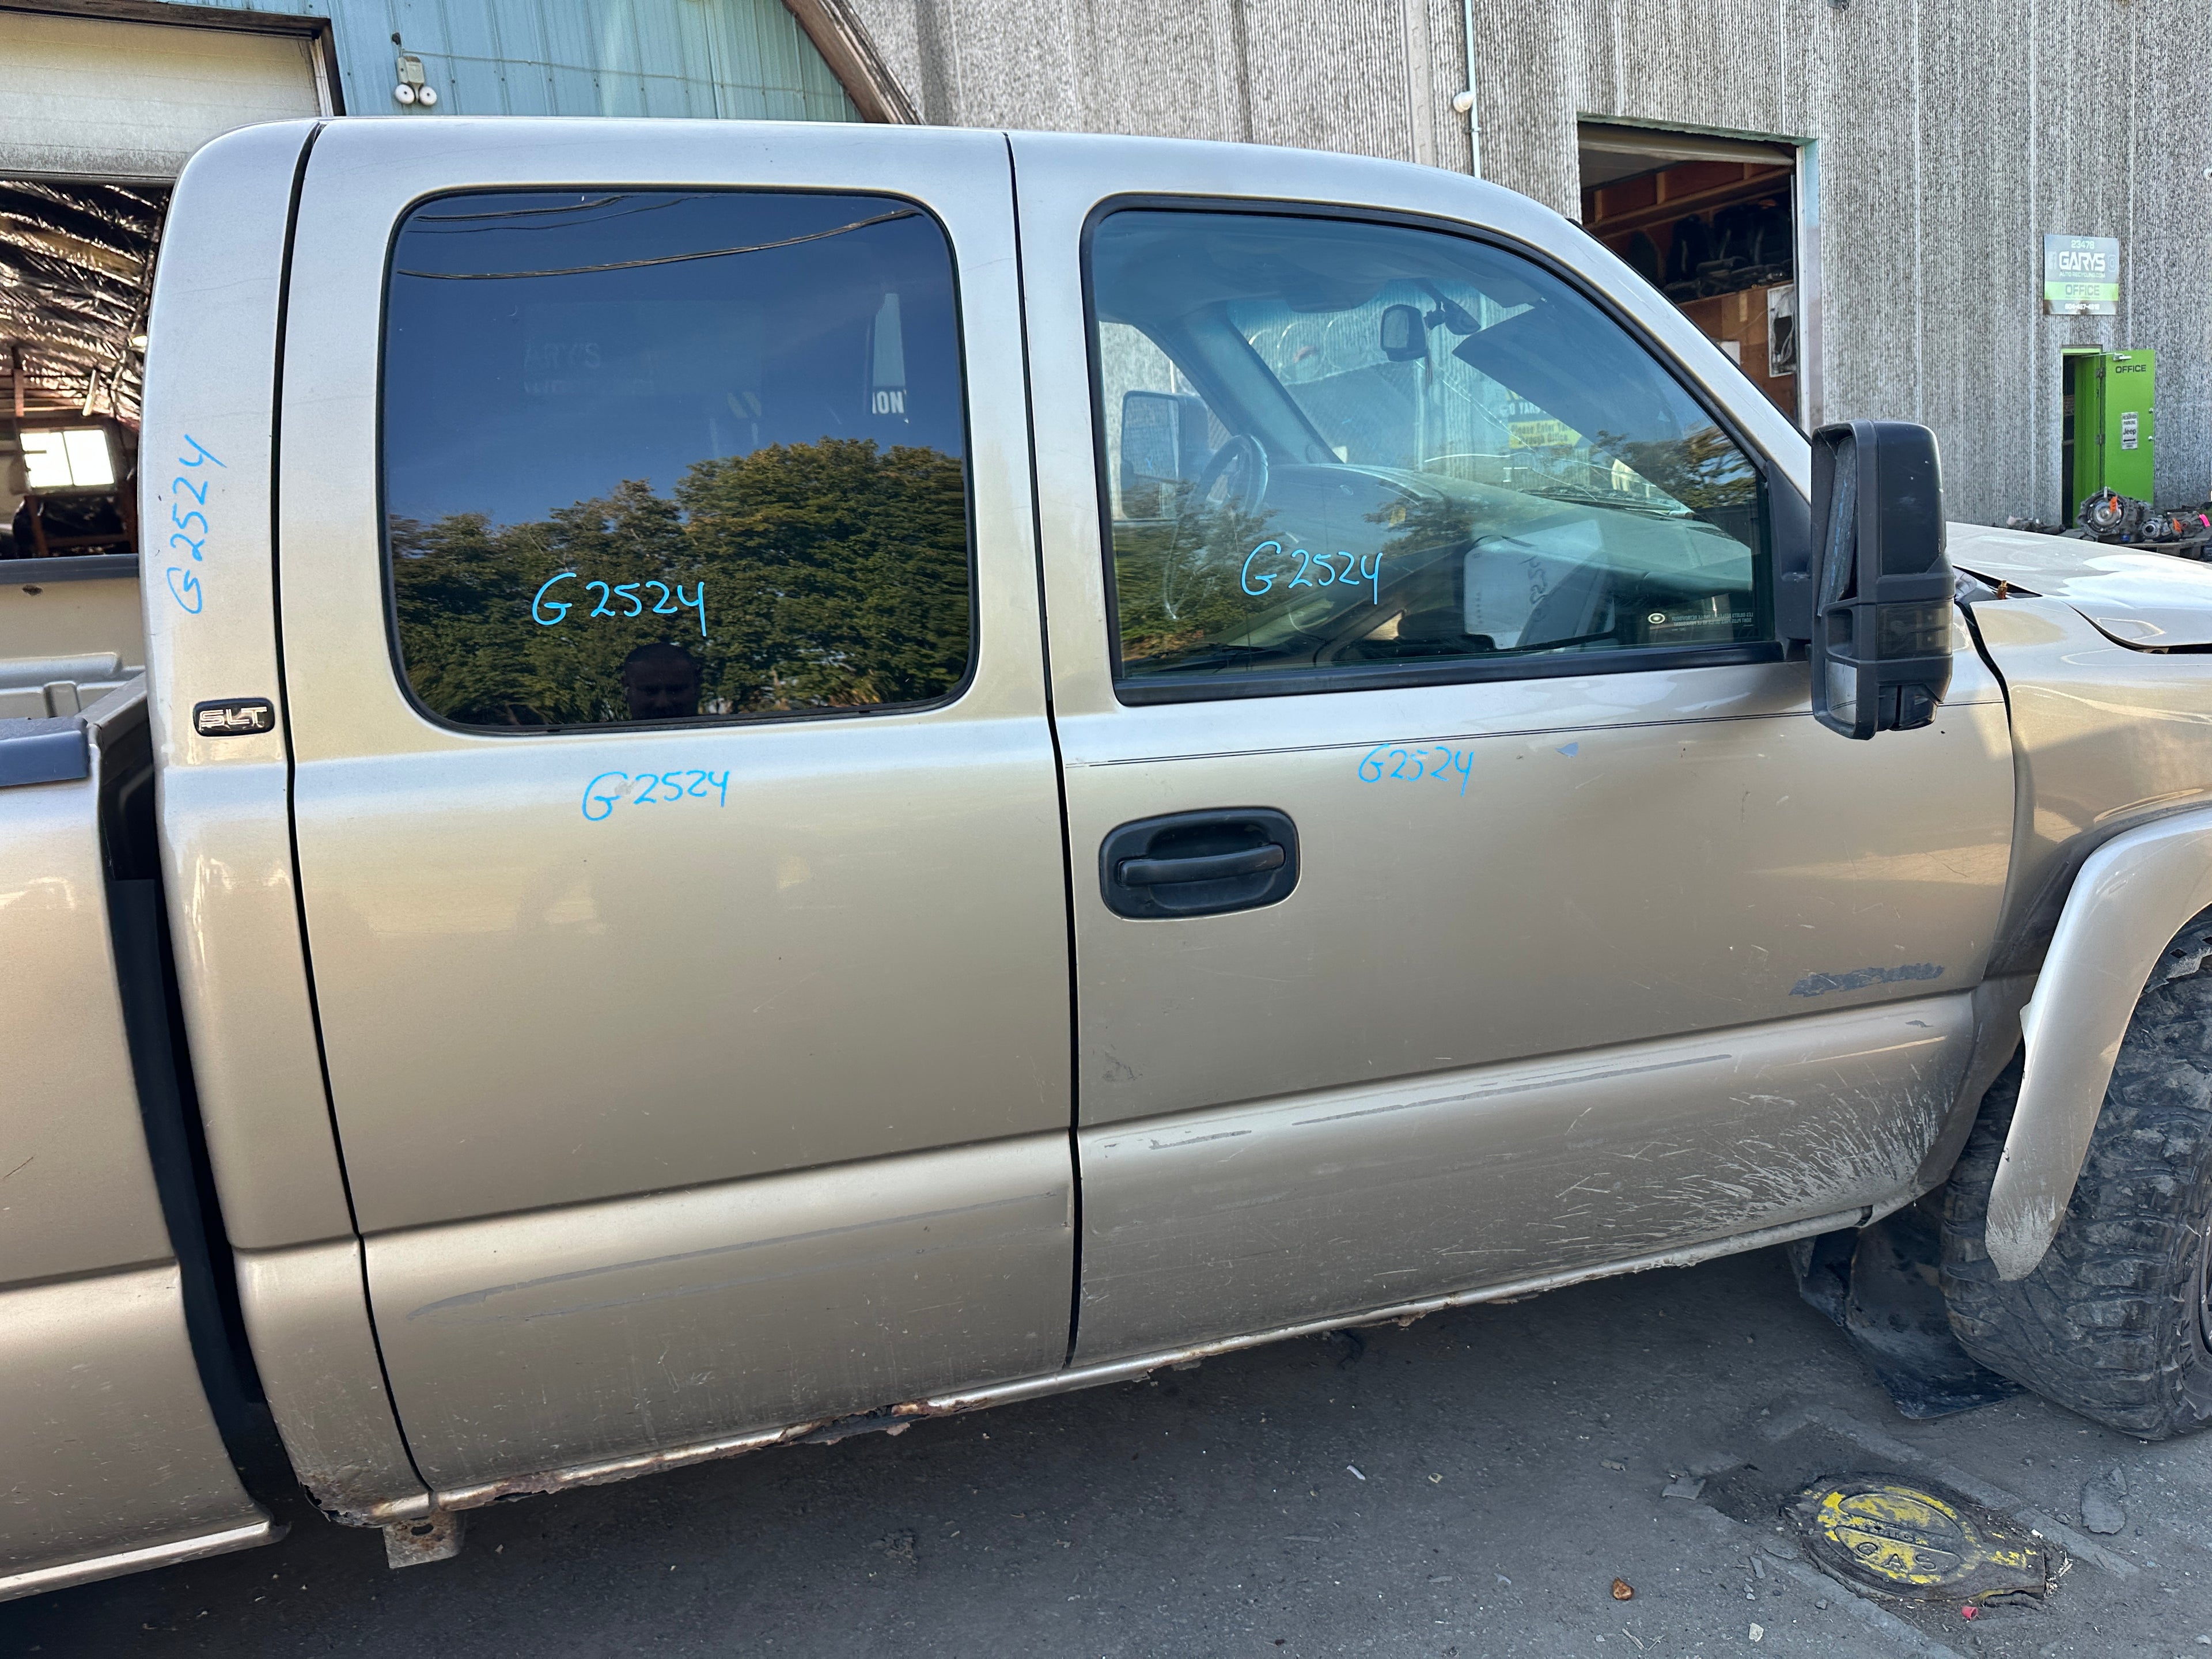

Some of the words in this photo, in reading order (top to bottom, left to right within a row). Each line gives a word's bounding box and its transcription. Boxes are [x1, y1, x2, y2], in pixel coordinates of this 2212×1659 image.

[2071, 239, 2095, 249] 23478
[2059, 251, 2106, 272] GARYS
[2065, 284, 2100, 296] OFFICE
[2115, 365, 2147, 373] OFFICE
[199, 706, 267, 728] SLT
[1358, 743, 1475, 797] G2524
[1857, 1541, 1938, 1574] GAS
